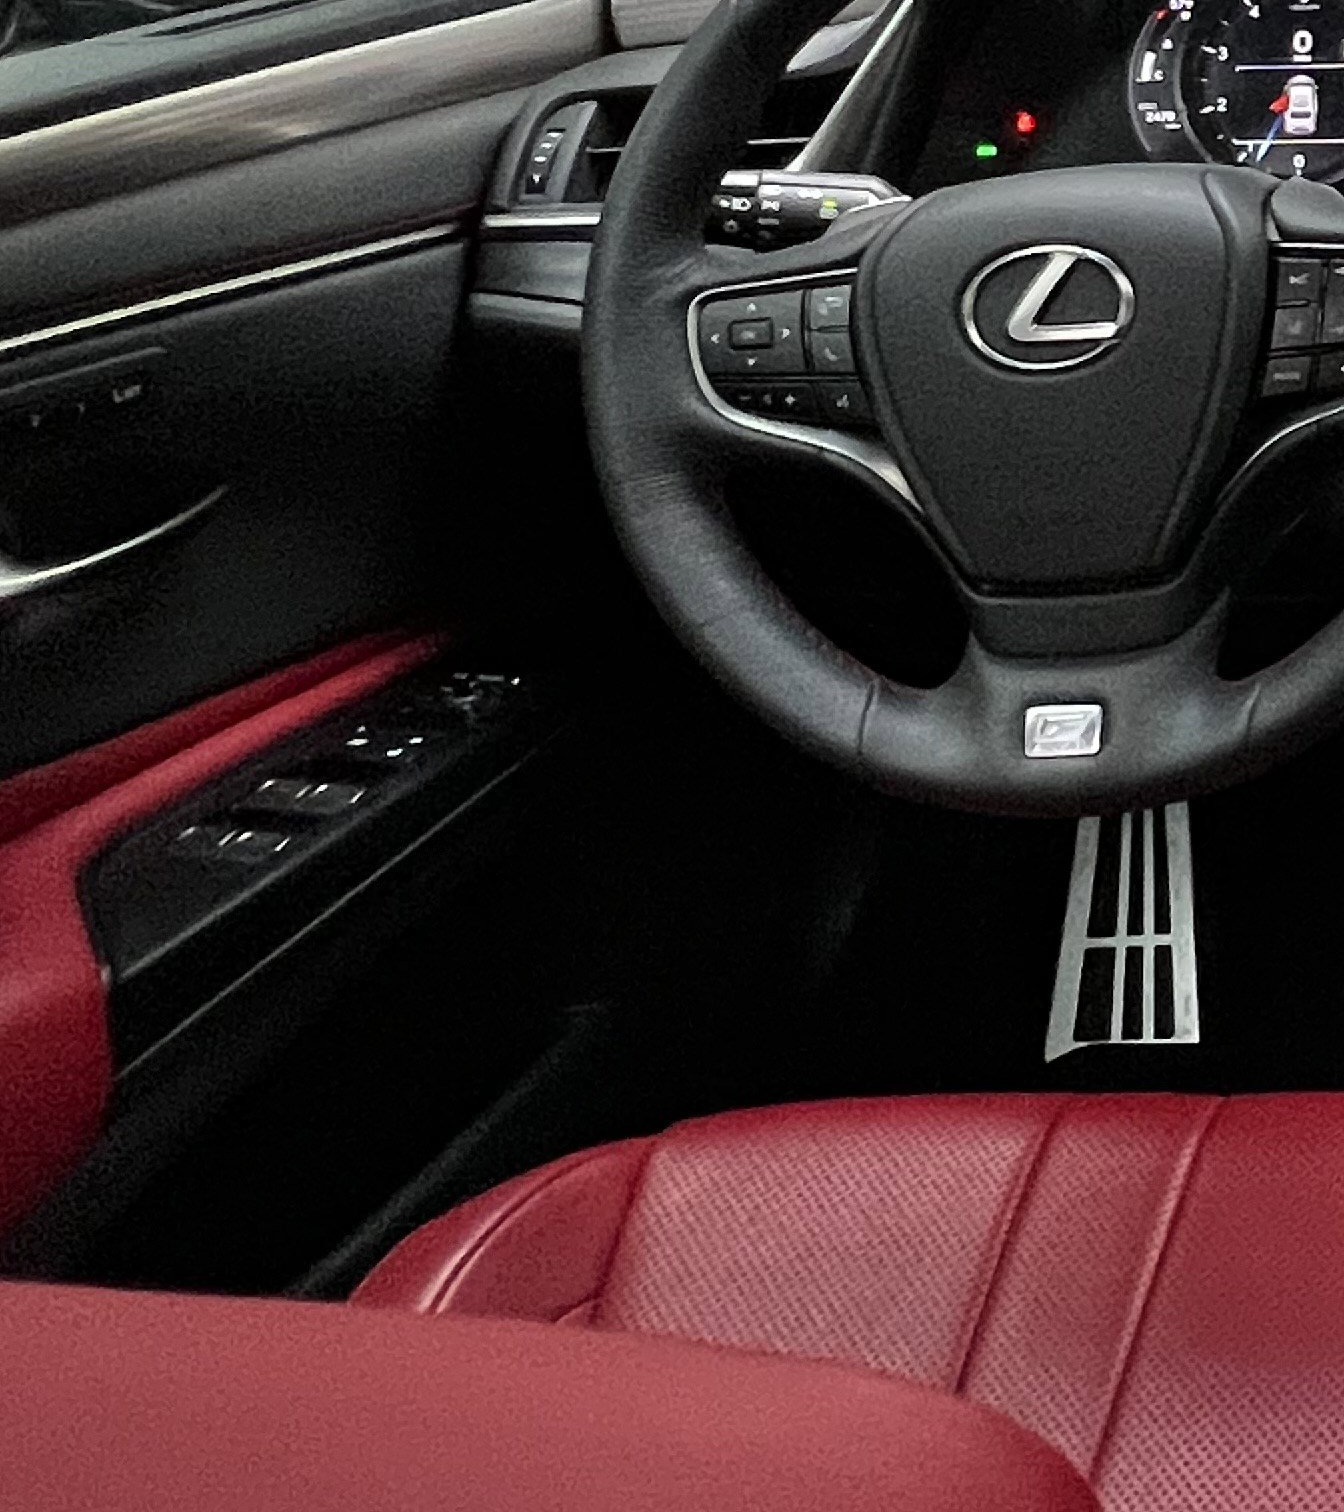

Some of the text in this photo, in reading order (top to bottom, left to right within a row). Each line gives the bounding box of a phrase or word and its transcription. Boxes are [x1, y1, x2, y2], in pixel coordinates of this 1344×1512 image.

[1249, 4, 1261, 19] 4
[1216, 45, 1229, 61] 3
[1216, 96, 1228, 112] 2
